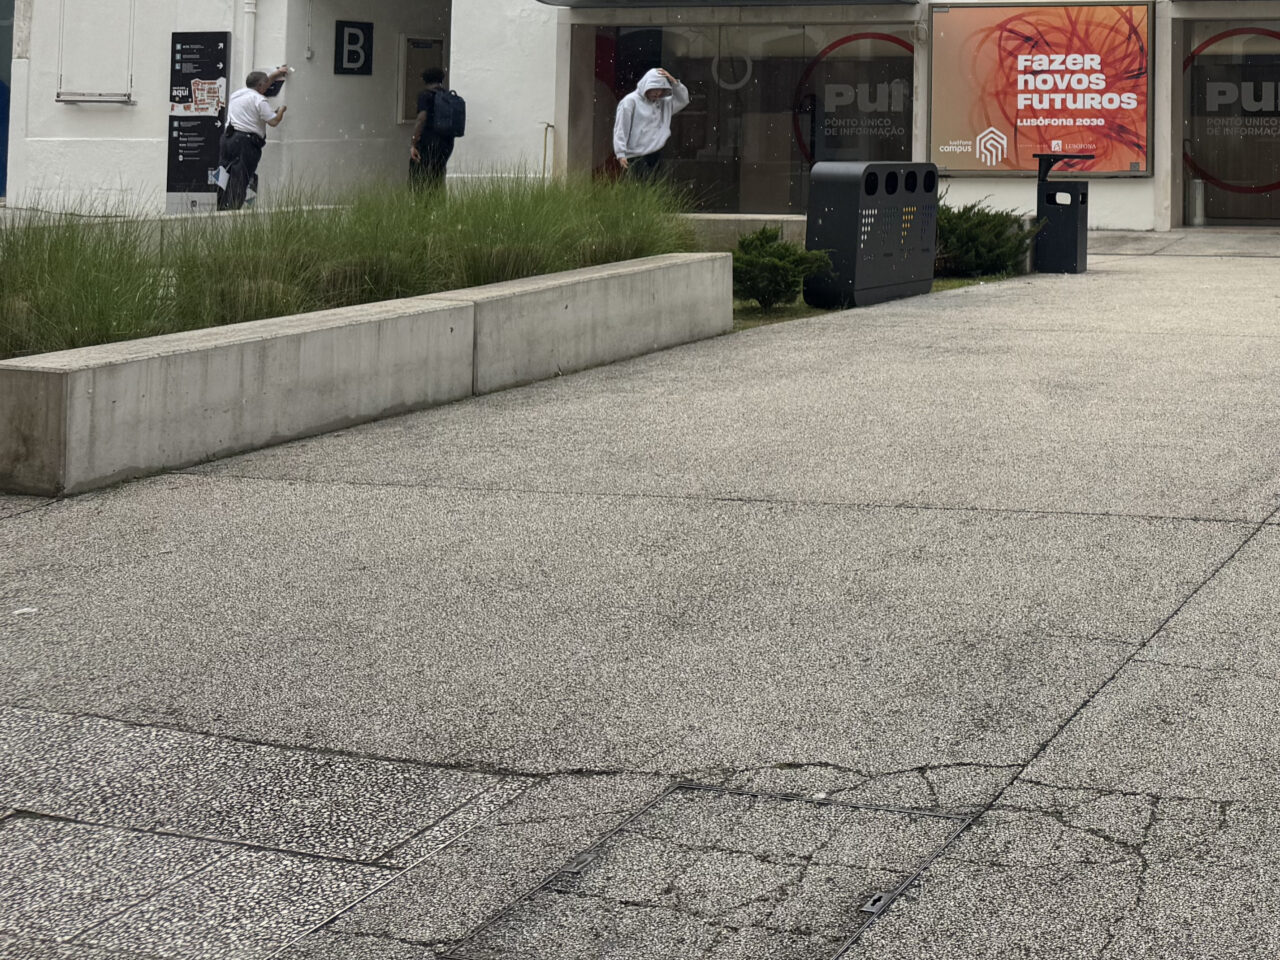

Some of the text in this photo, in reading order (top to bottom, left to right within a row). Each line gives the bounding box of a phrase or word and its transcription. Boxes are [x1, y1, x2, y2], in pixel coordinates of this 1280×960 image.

[343, 26, 365, 68] B
[824, 128, 838, 136] DE
[1206, 128, 1221, 136] DE
[939, 145, 972, 153] campus
